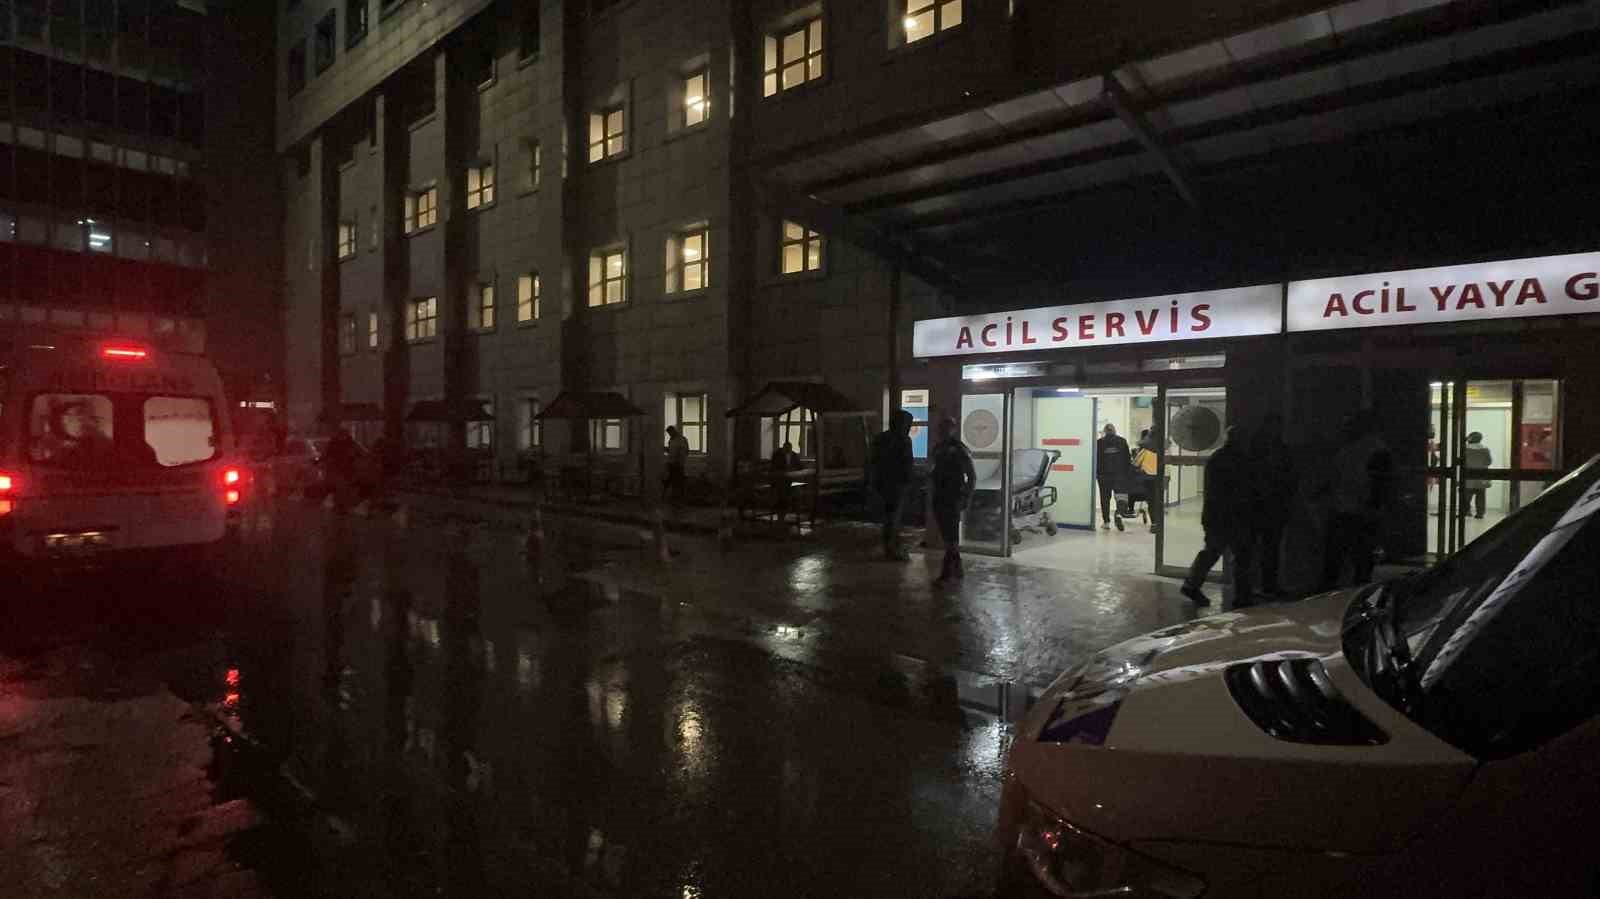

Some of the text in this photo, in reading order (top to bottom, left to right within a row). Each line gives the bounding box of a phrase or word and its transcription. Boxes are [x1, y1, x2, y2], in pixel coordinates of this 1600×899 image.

[1322, 281, 1417, 318] ACİL
[1429, 277, 1548, 311] YAYA
[956, 299, 1212, 349] ACİL SERVİS
